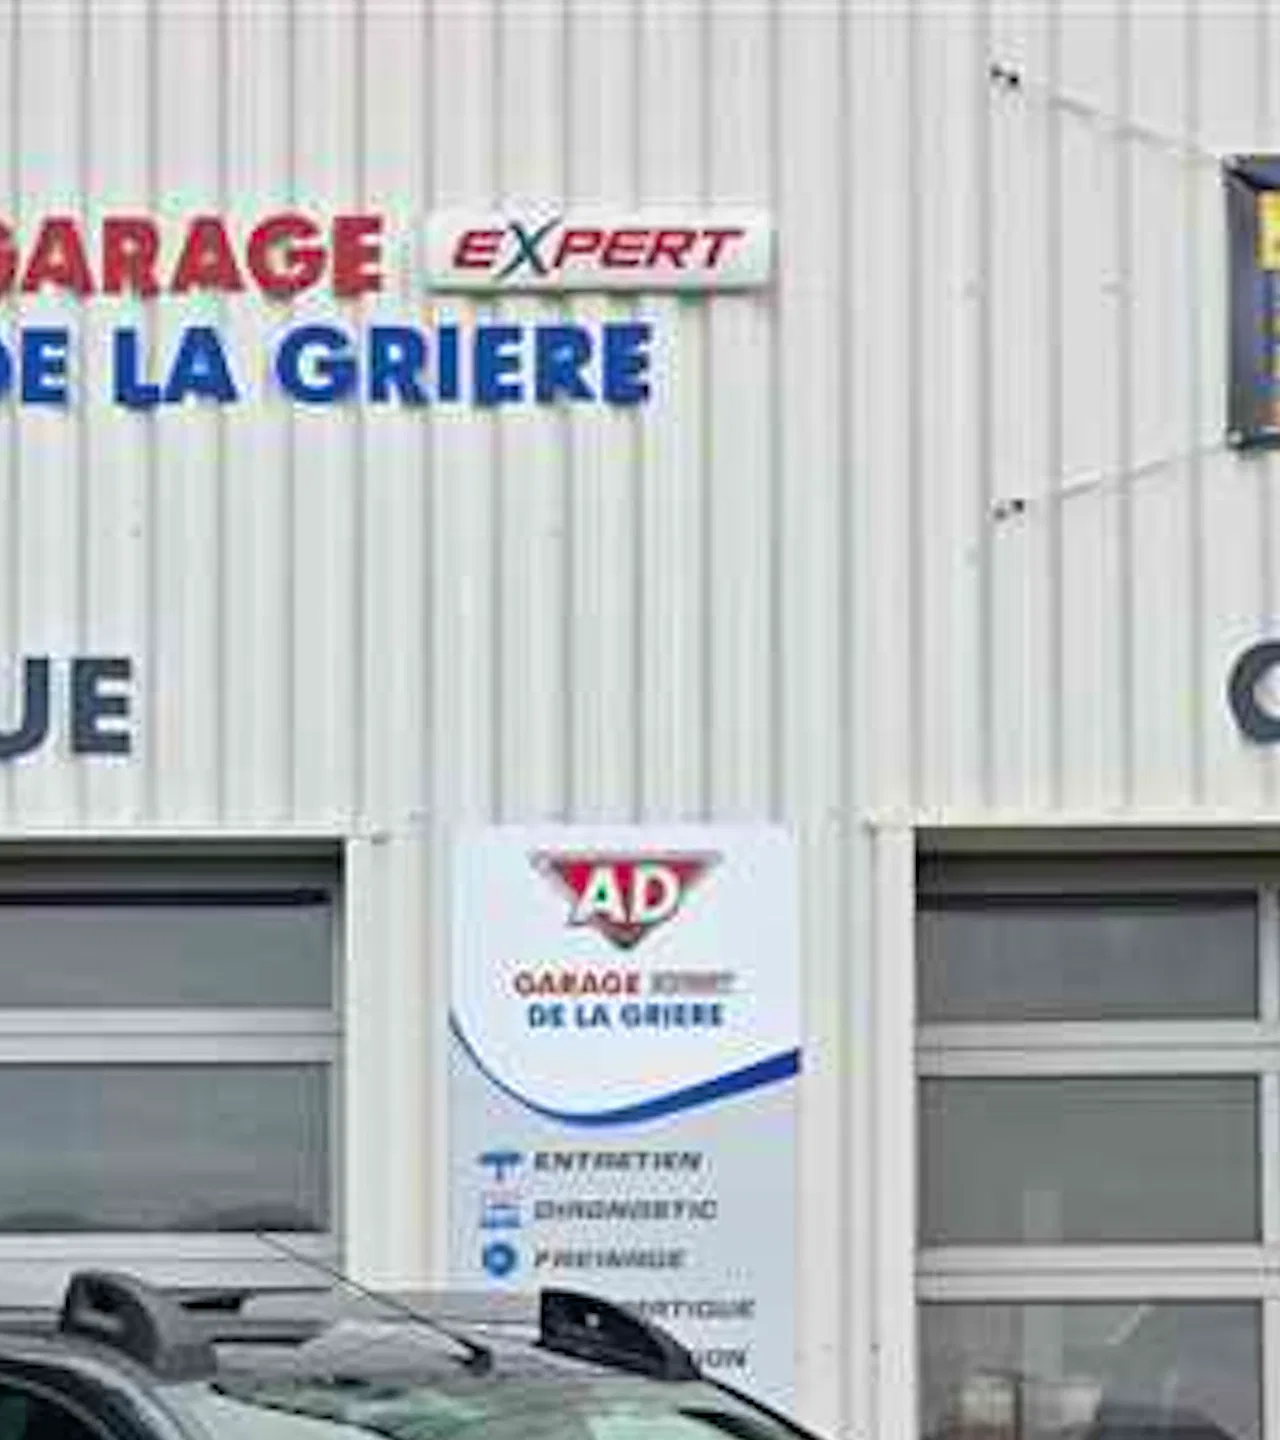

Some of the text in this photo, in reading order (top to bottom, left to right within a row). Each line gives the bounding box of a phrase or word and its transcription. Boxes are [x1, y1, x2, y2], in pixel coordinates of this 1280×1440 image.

[113, 325, 237, 404] LA
[274, 325, 654, 404] GRIERE
[568, 862, 684, 924] AD
[513, 970, 640, 995] GARAGE
[527, 1003, 726, 1030] DE LA GRIERE
